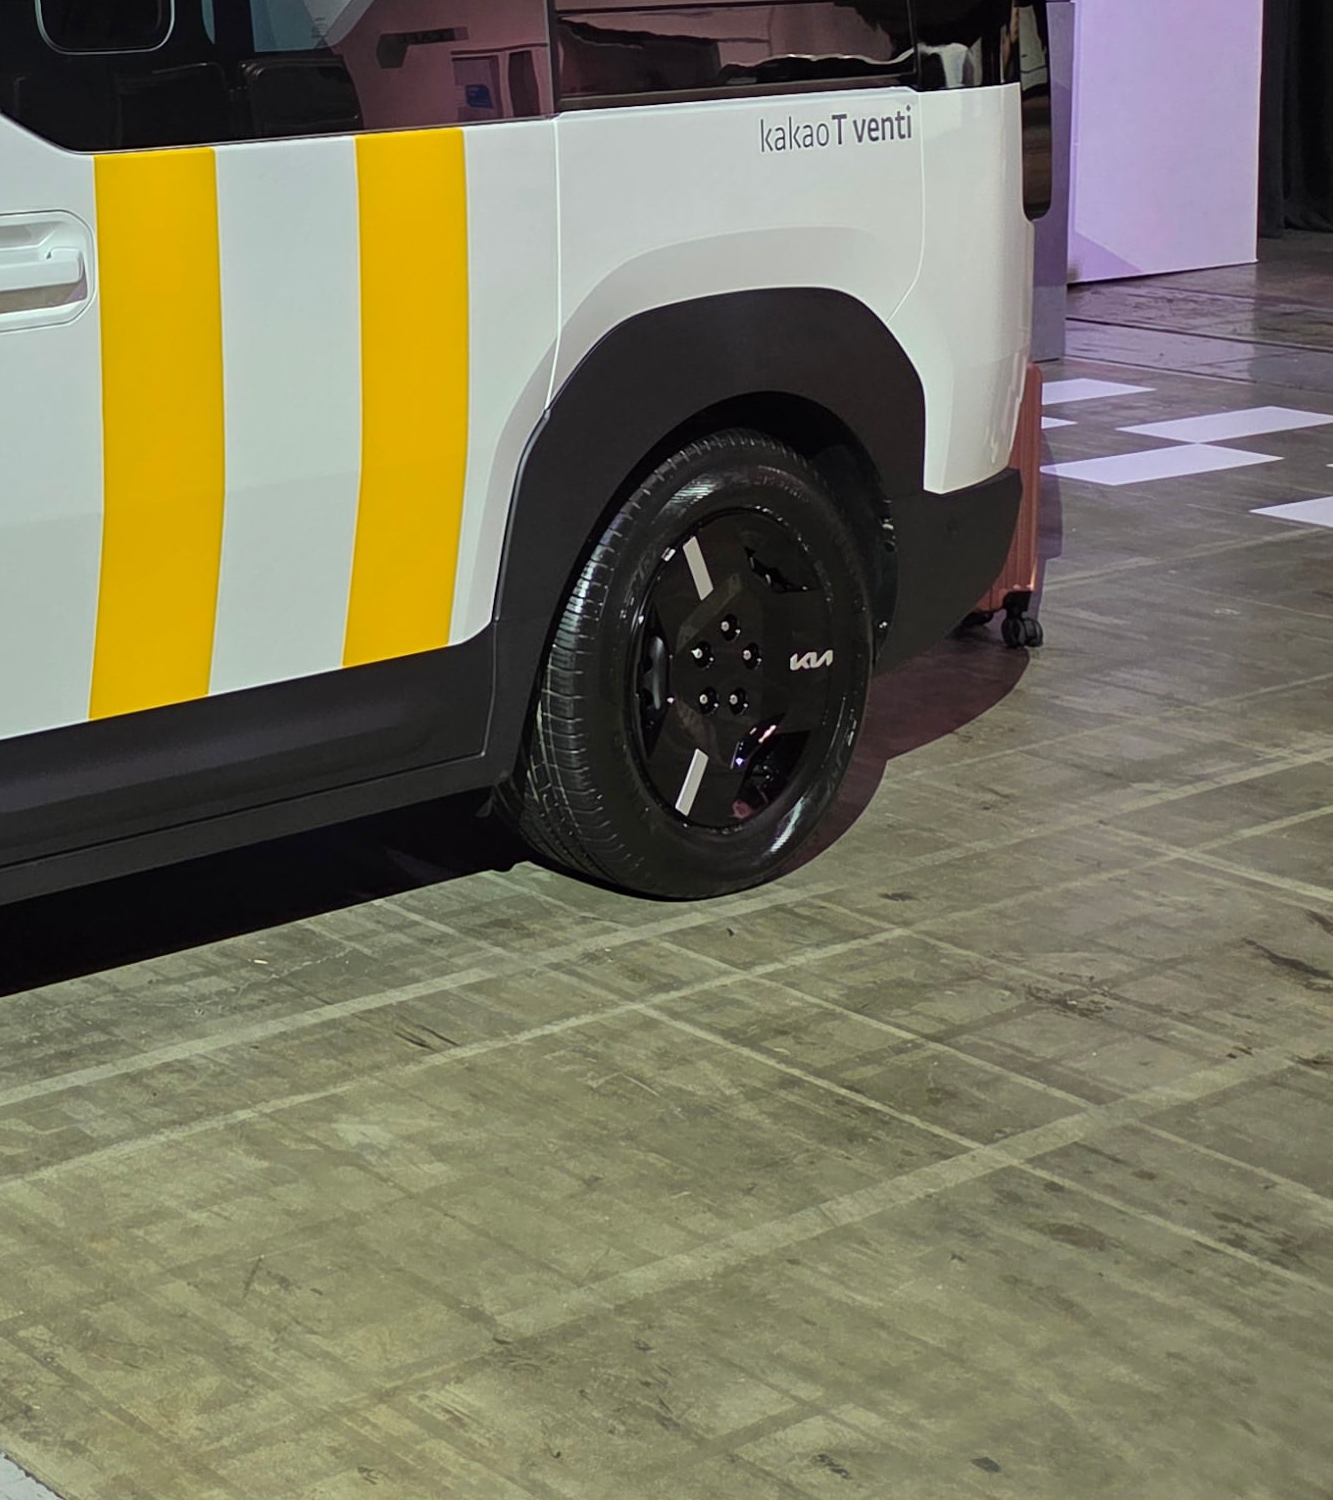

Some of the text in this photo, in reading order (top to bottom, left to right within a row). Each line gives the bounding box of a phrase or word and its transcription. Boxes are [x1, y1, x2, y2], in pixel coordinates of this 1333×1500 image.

[759, 105, 912, 153] kakao T venti
